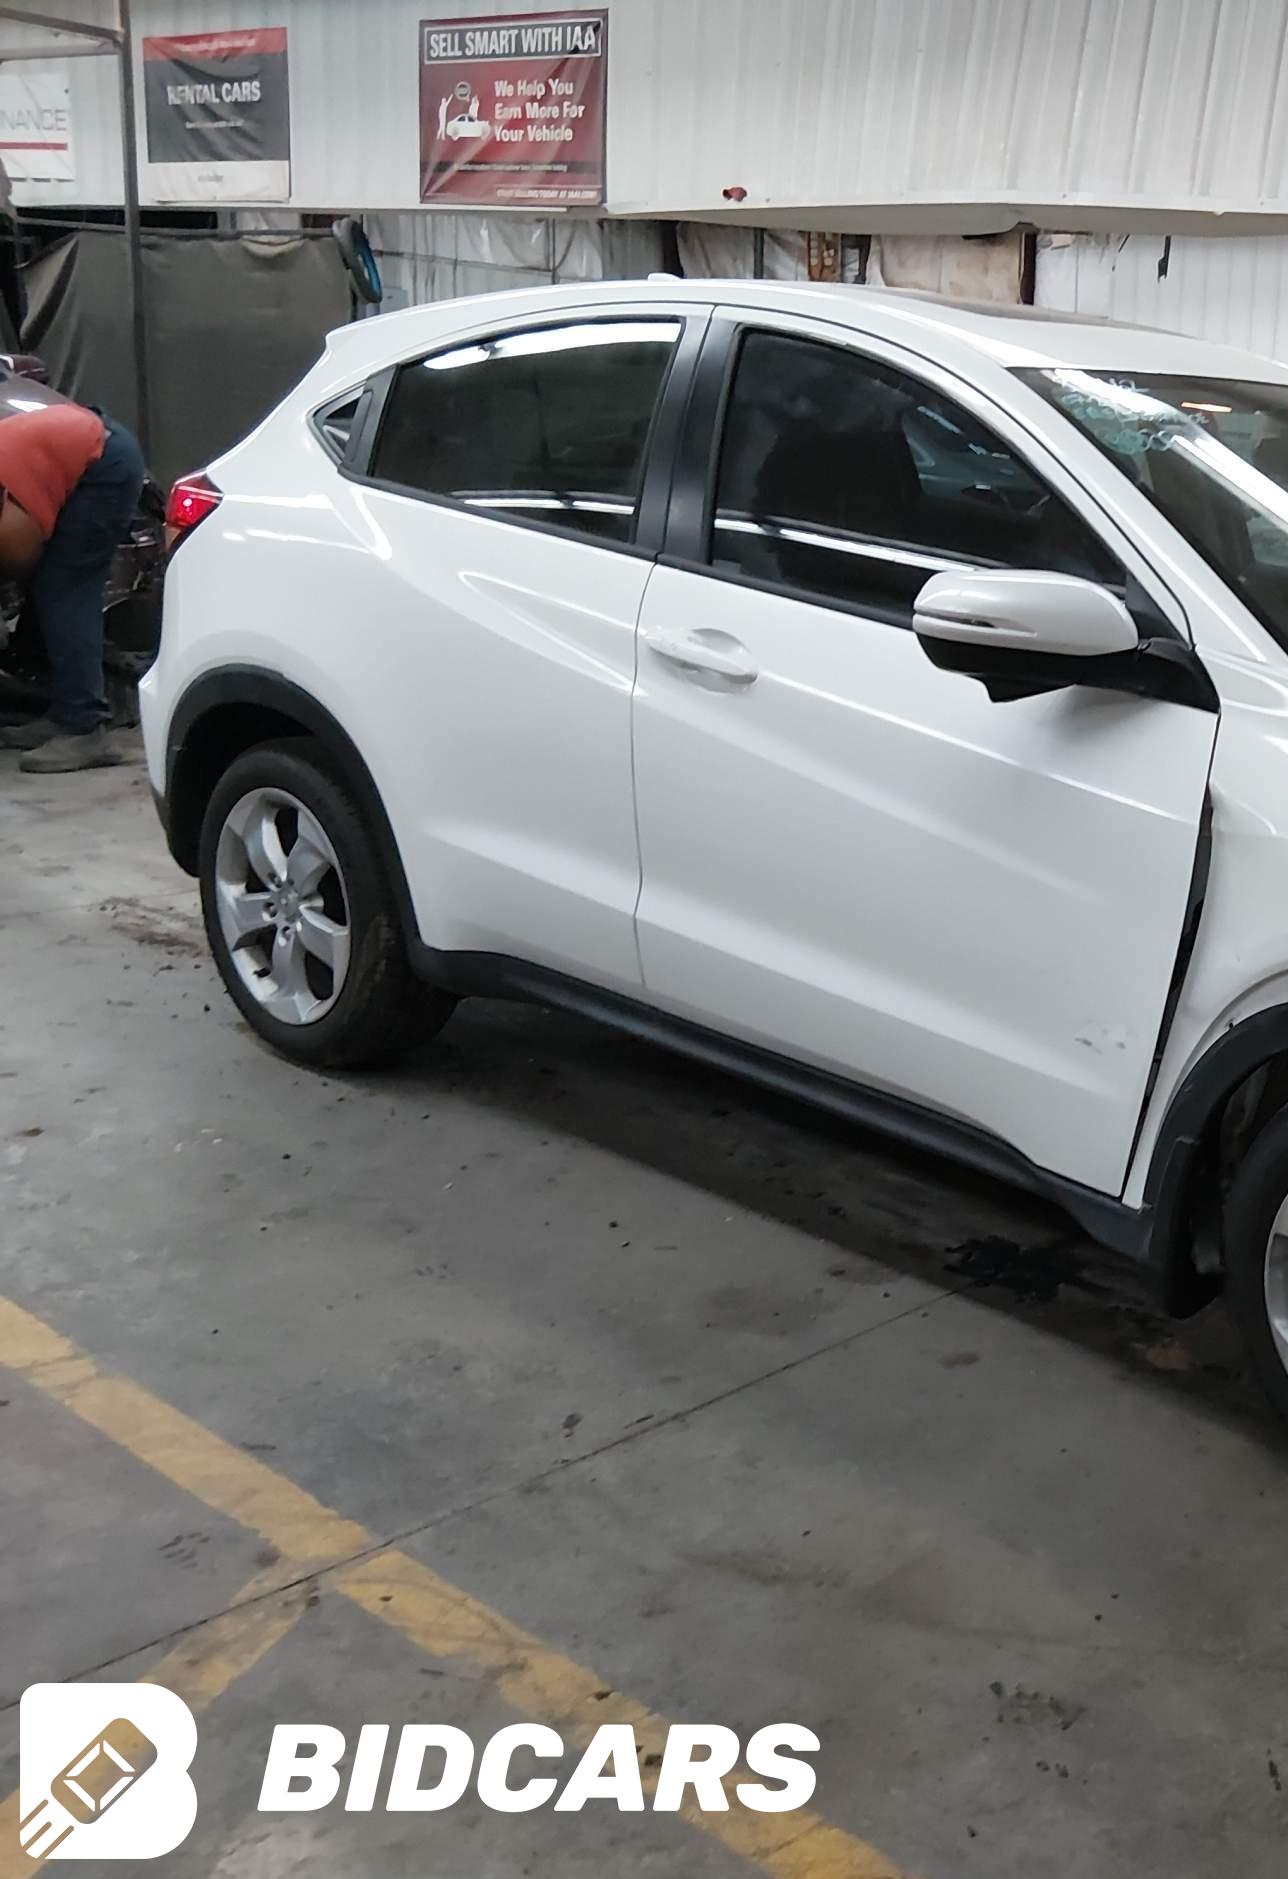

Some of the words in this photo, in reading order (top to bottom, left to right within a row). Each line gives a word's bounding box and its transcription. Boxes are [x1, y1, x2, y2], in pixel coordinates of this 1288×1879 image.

[430, 33, 462, 57] SELL
[465, 29, 518, 56] SMART
[521, 27, 563, 53] WITH
[566, 25, 596, 51] IAA
[167, 84, 220, 105] RENTAL
[221, 81, 261, 102] CARS
[494, 80, 514, 97] We
[517, 79, 545, 99] Help
[548, 78, 574, 96] You
[525, 102, 558, 118] More
[562, 101, 585, 118] For
[494, 126, 524, 142] Your
[527, 125, 573, 142] Vehicle
